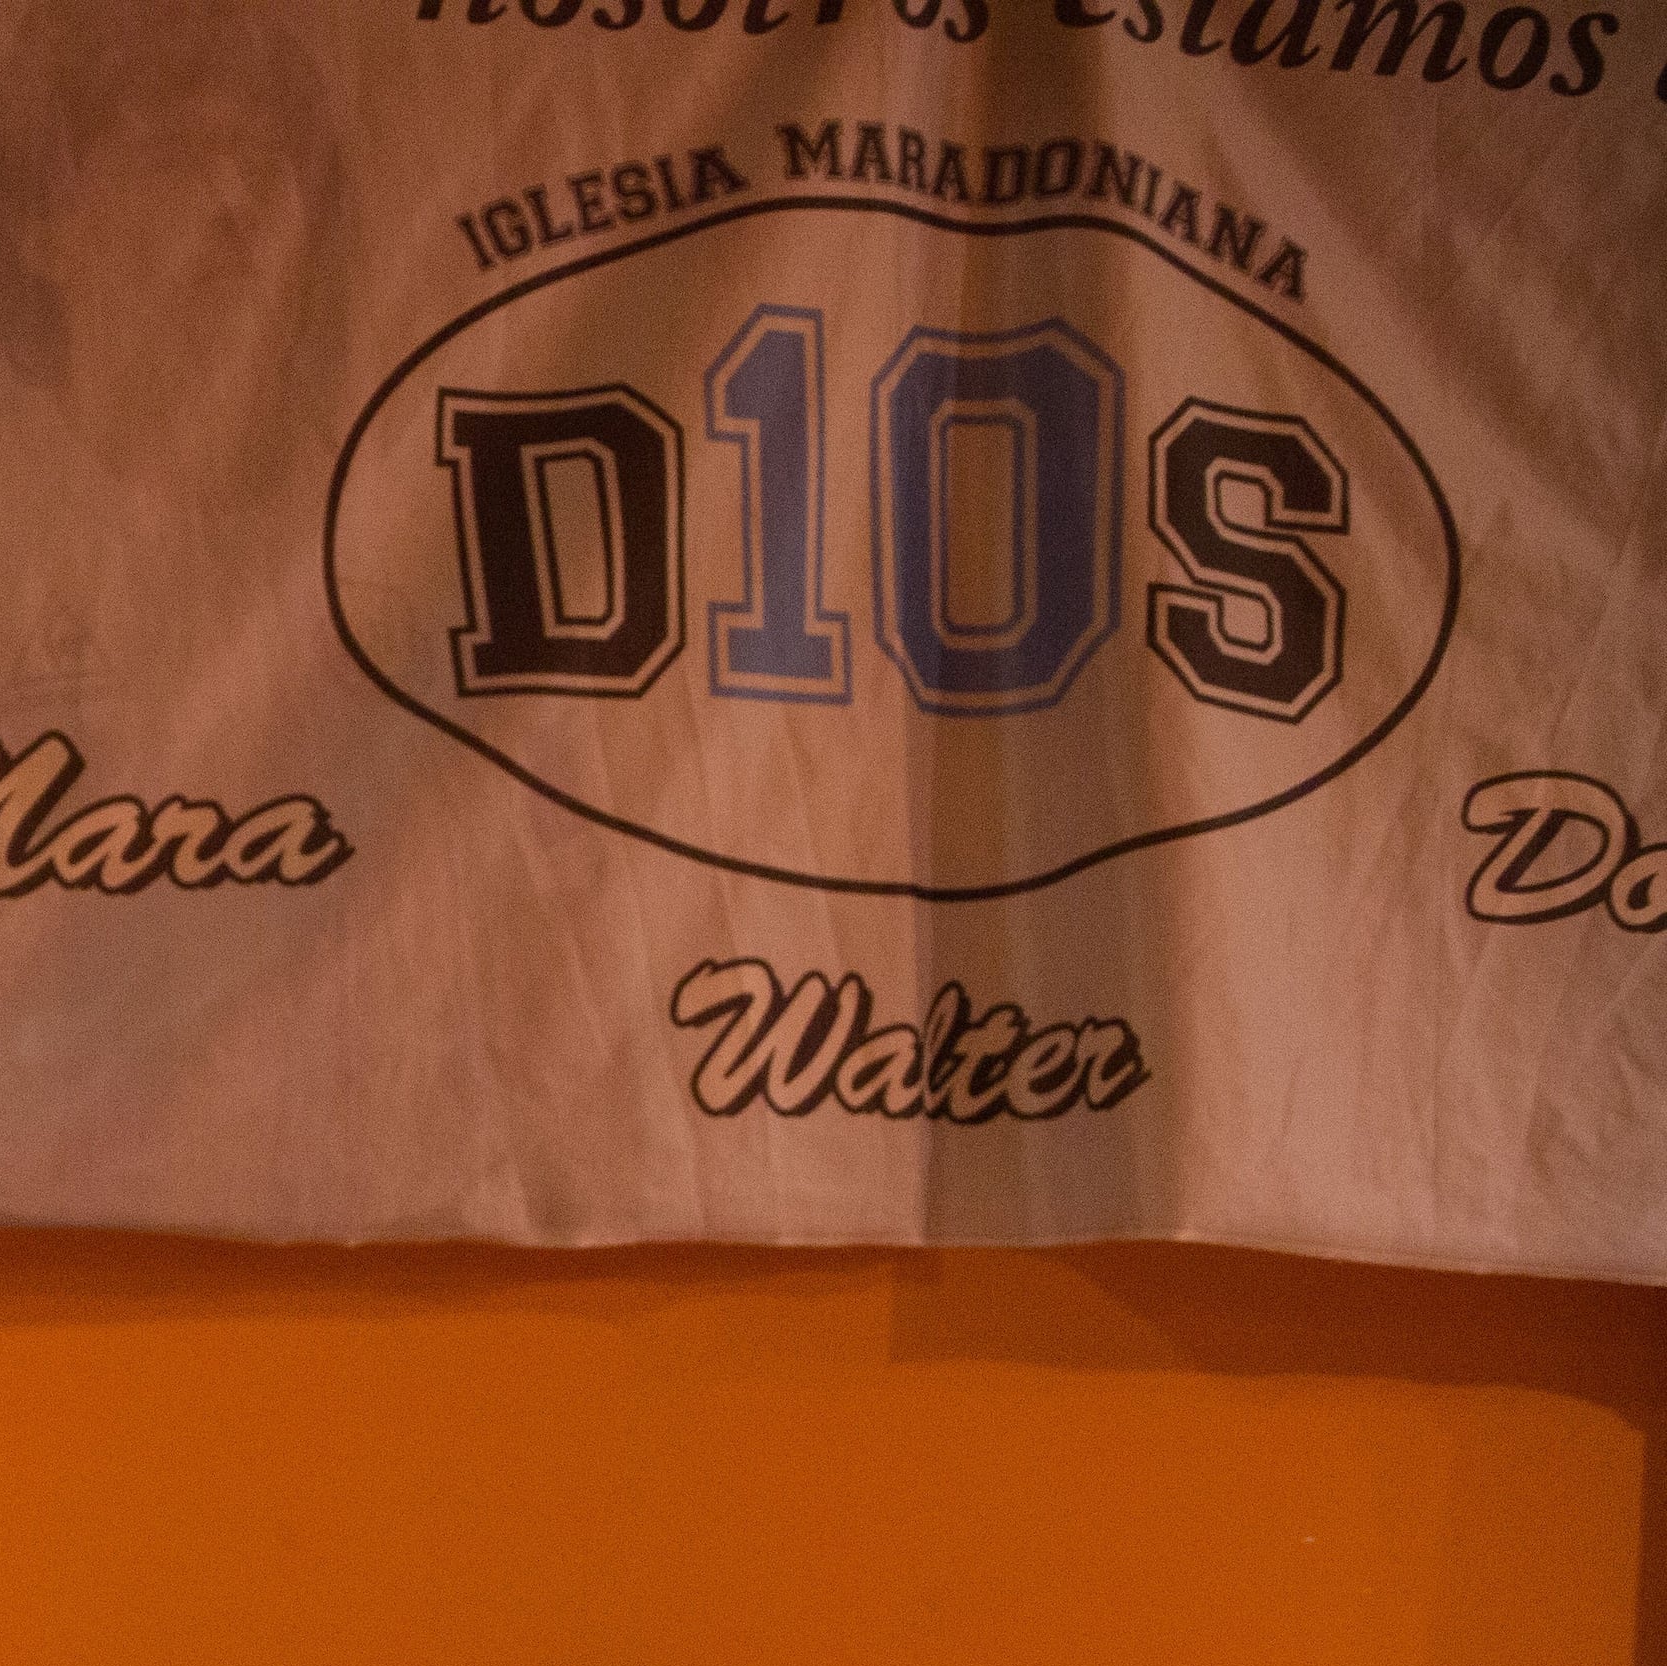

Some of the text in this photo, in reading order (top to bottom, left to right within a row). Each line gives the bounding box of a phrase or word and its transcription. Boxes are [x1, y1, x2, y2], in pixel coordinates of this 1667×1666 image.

[455, 118, 1309, 303] IGLESIA MARADONIANA
[436, 303, 1351, 725] D10S
[670, 956, 1152, 1126] Walter
